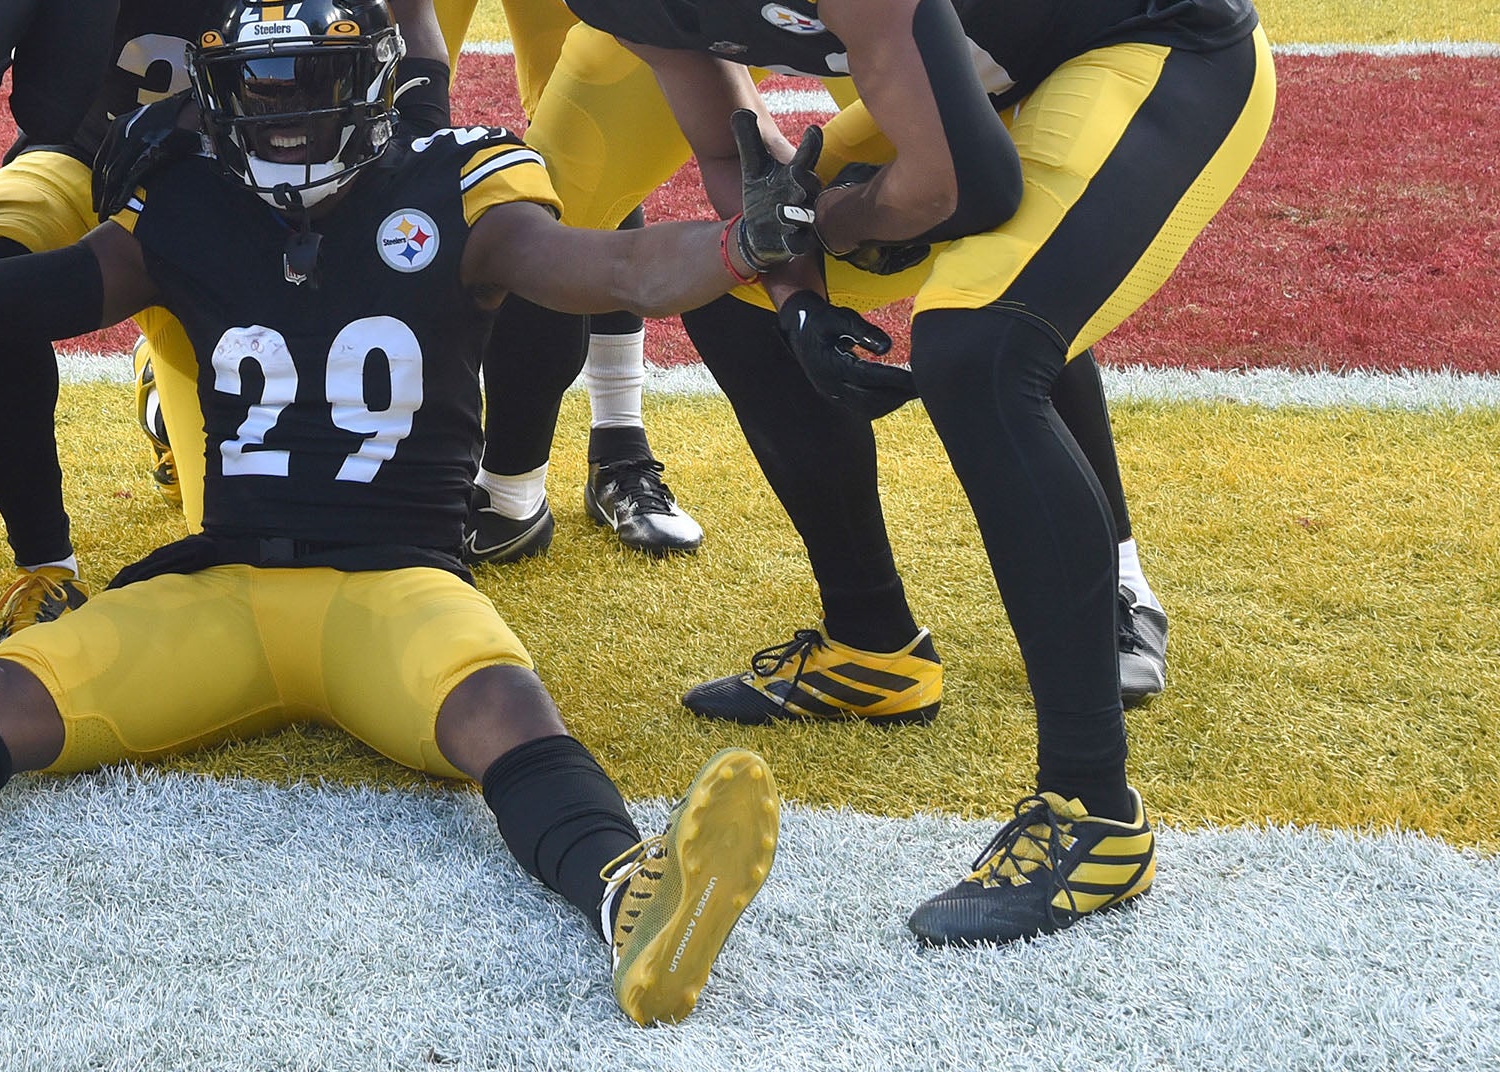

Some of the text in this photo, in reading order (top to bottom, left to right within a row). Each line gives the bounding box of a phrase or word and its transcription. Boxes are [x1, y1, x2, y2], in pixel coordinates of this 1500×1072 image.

[254, 23, 292, 36] Steelers
[382, 237, 407, 247] Steelers
[211, 315, 424, 484] 29
[668, 876, 718, 973] UNDER ARMOUR
